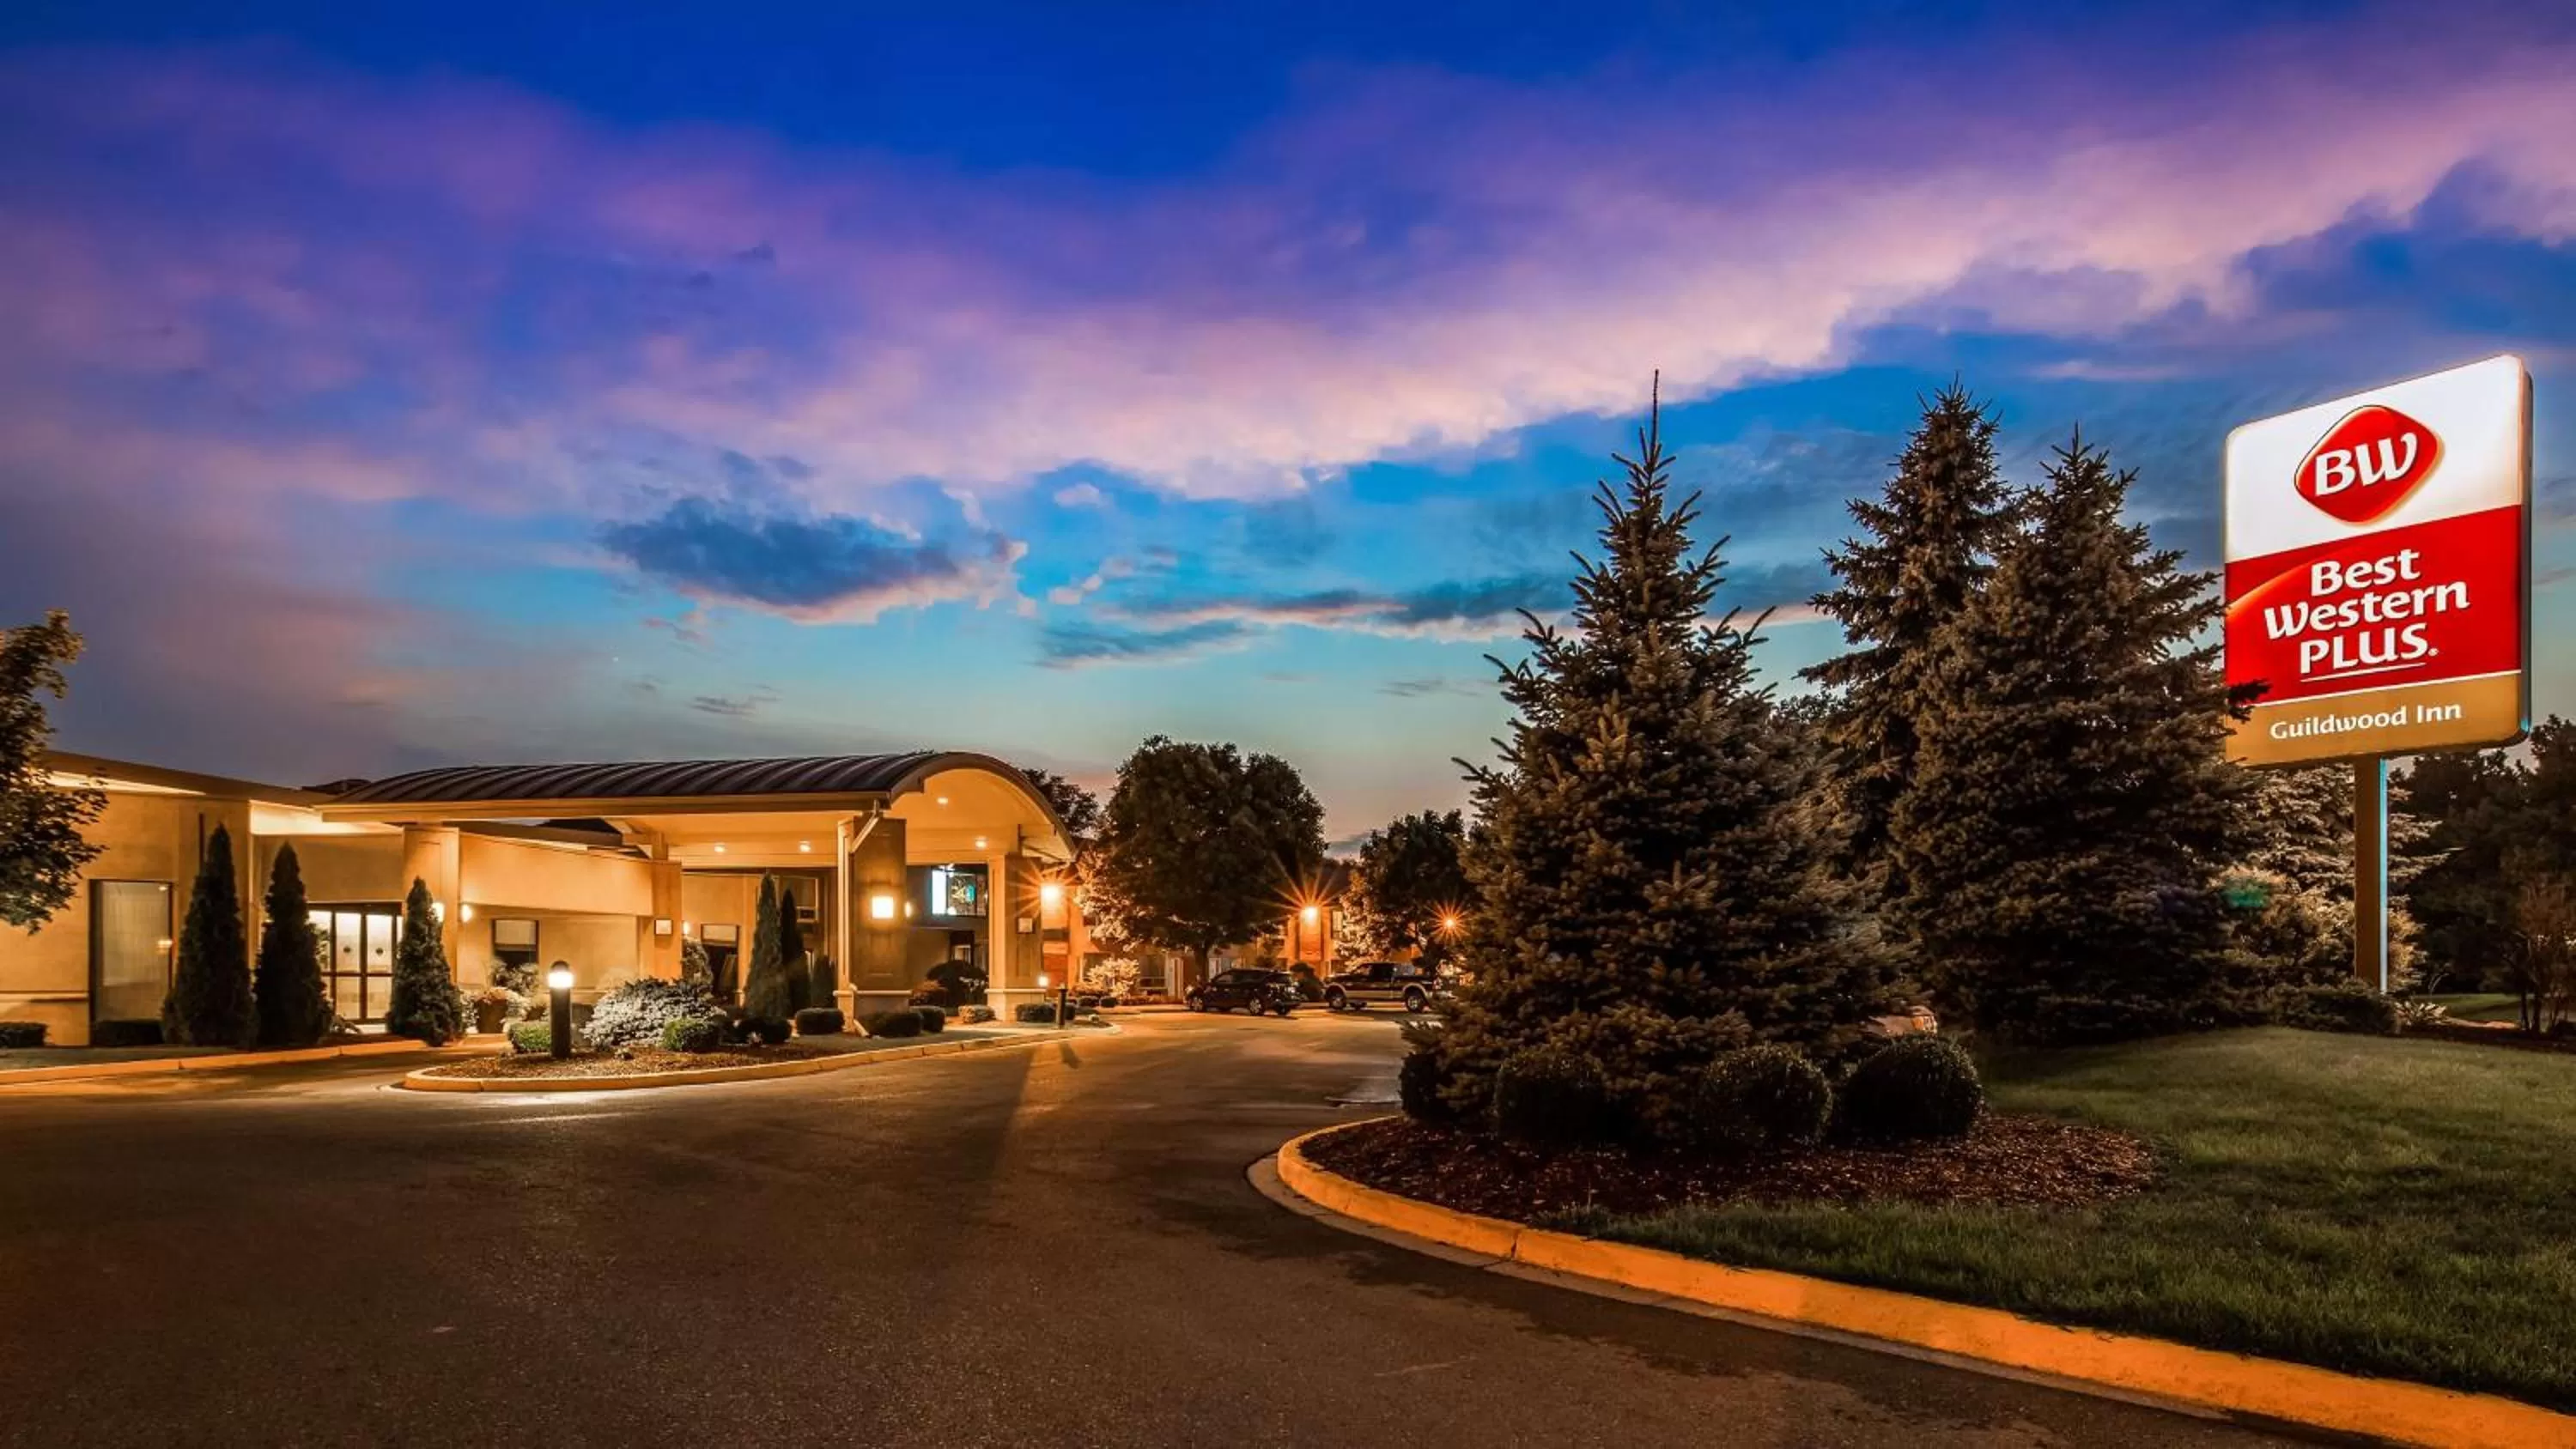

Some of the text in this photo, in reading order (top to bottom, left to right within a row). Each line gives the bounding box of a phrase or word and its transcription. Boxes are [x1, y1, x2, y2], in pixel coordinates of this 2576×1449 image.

[2314, 433, 2417, 496] BW
[2311, 549, 2420, 597] Best
[2264, 581, 2470, 640] Western
[2269, 703, 2462, 740] Guildwood Inn
